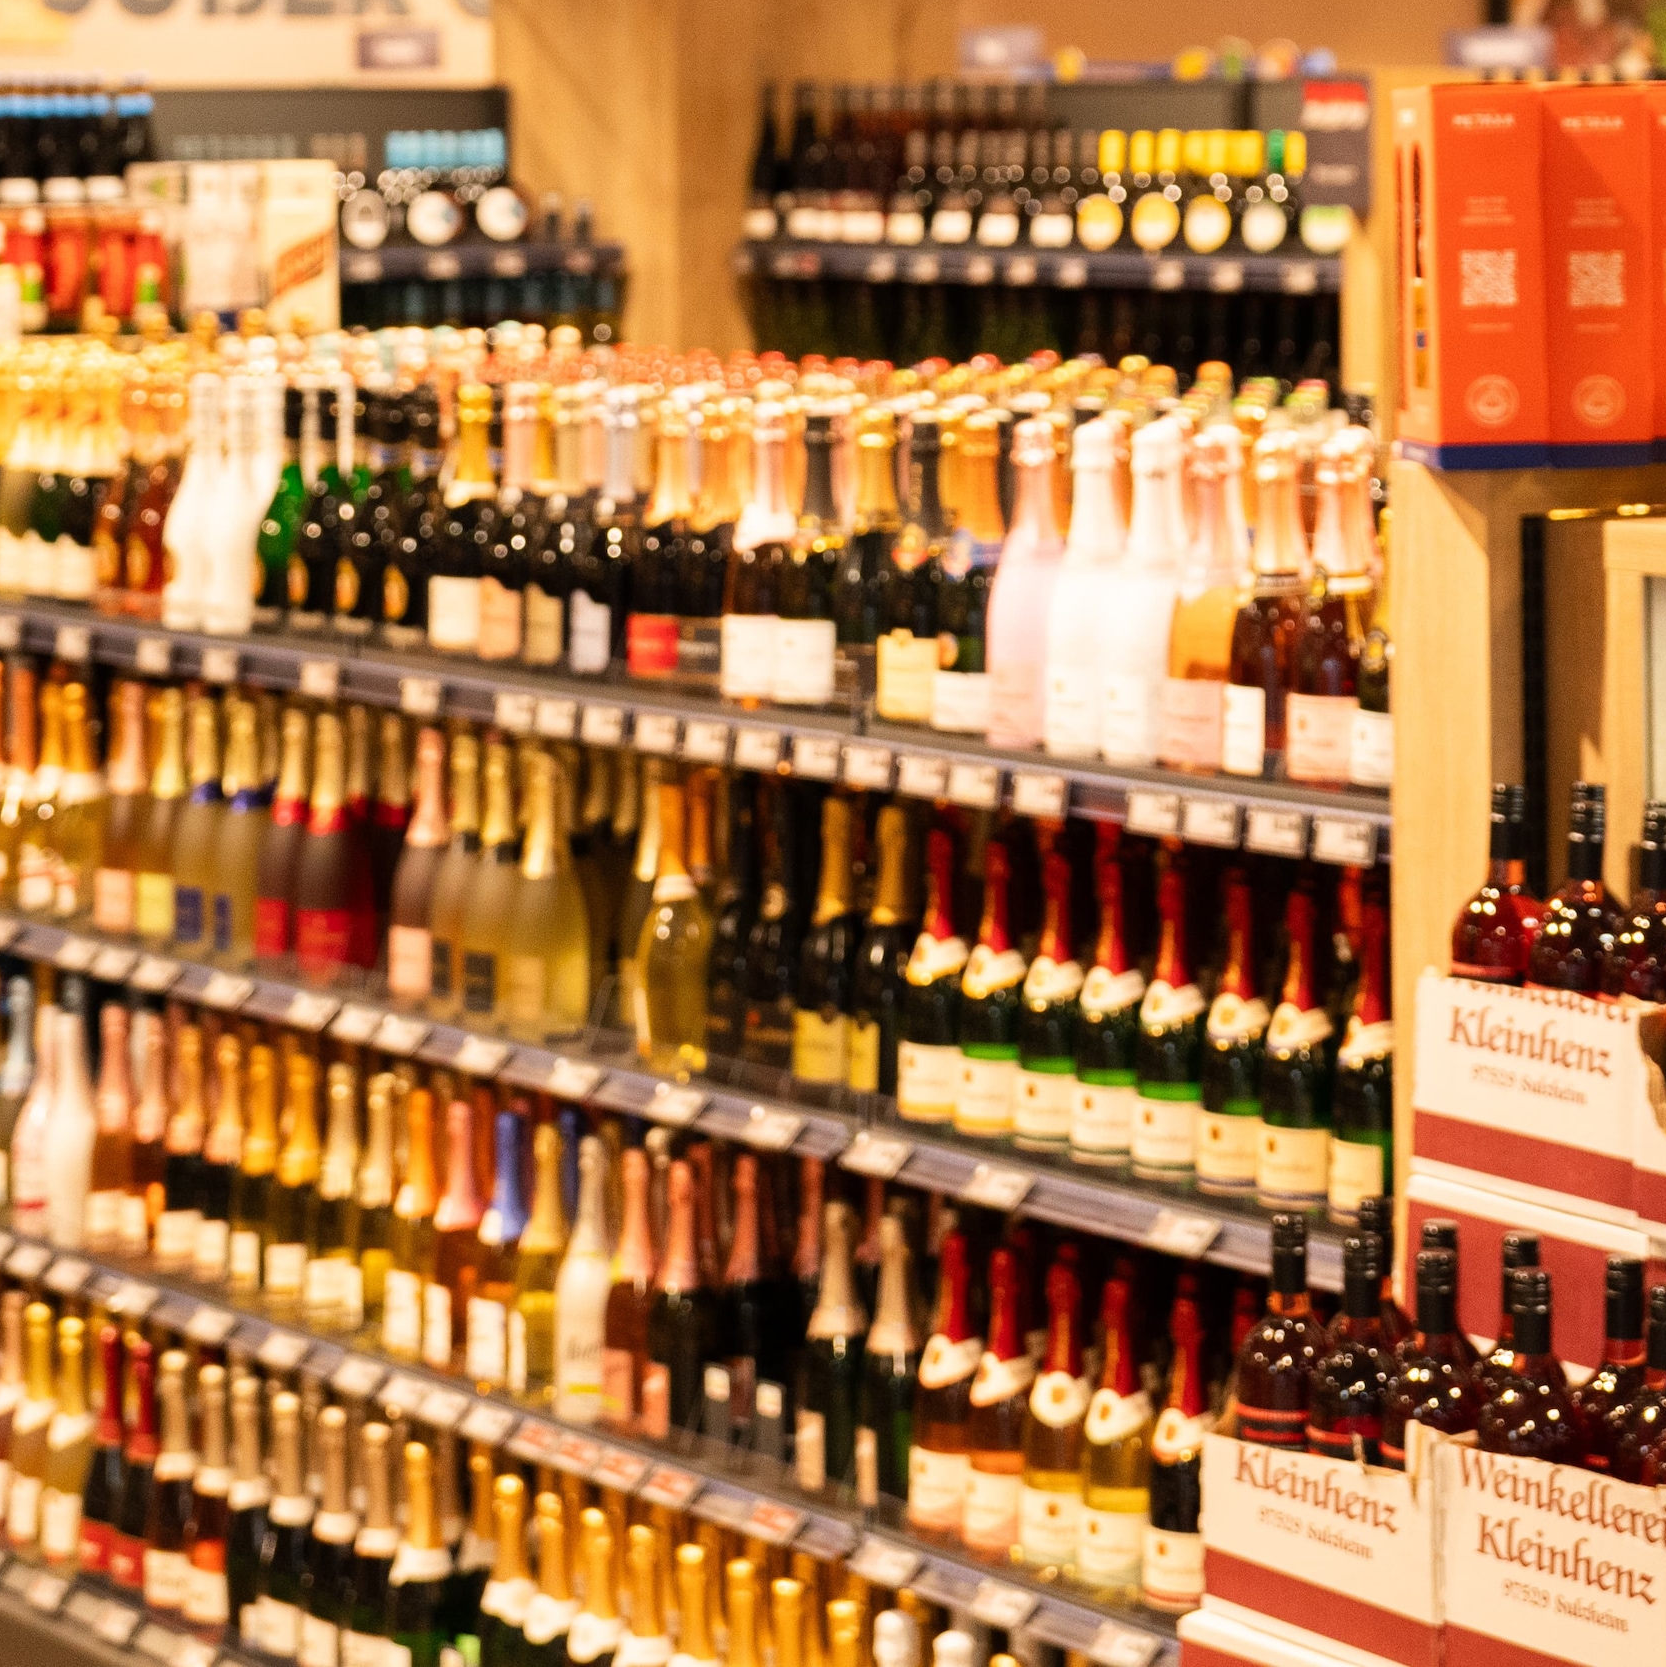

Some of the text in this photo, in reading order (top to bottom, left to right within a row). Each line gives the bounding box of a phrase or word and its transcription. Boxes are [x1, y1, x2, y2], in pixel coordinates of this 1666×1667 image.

[1448, 1005, 1612, 1078] Kleinhenz
[1233, 1442, 1399, 1535] Kleinhenz
[1475, 1513, 1659, 1606] Kleinhenz
